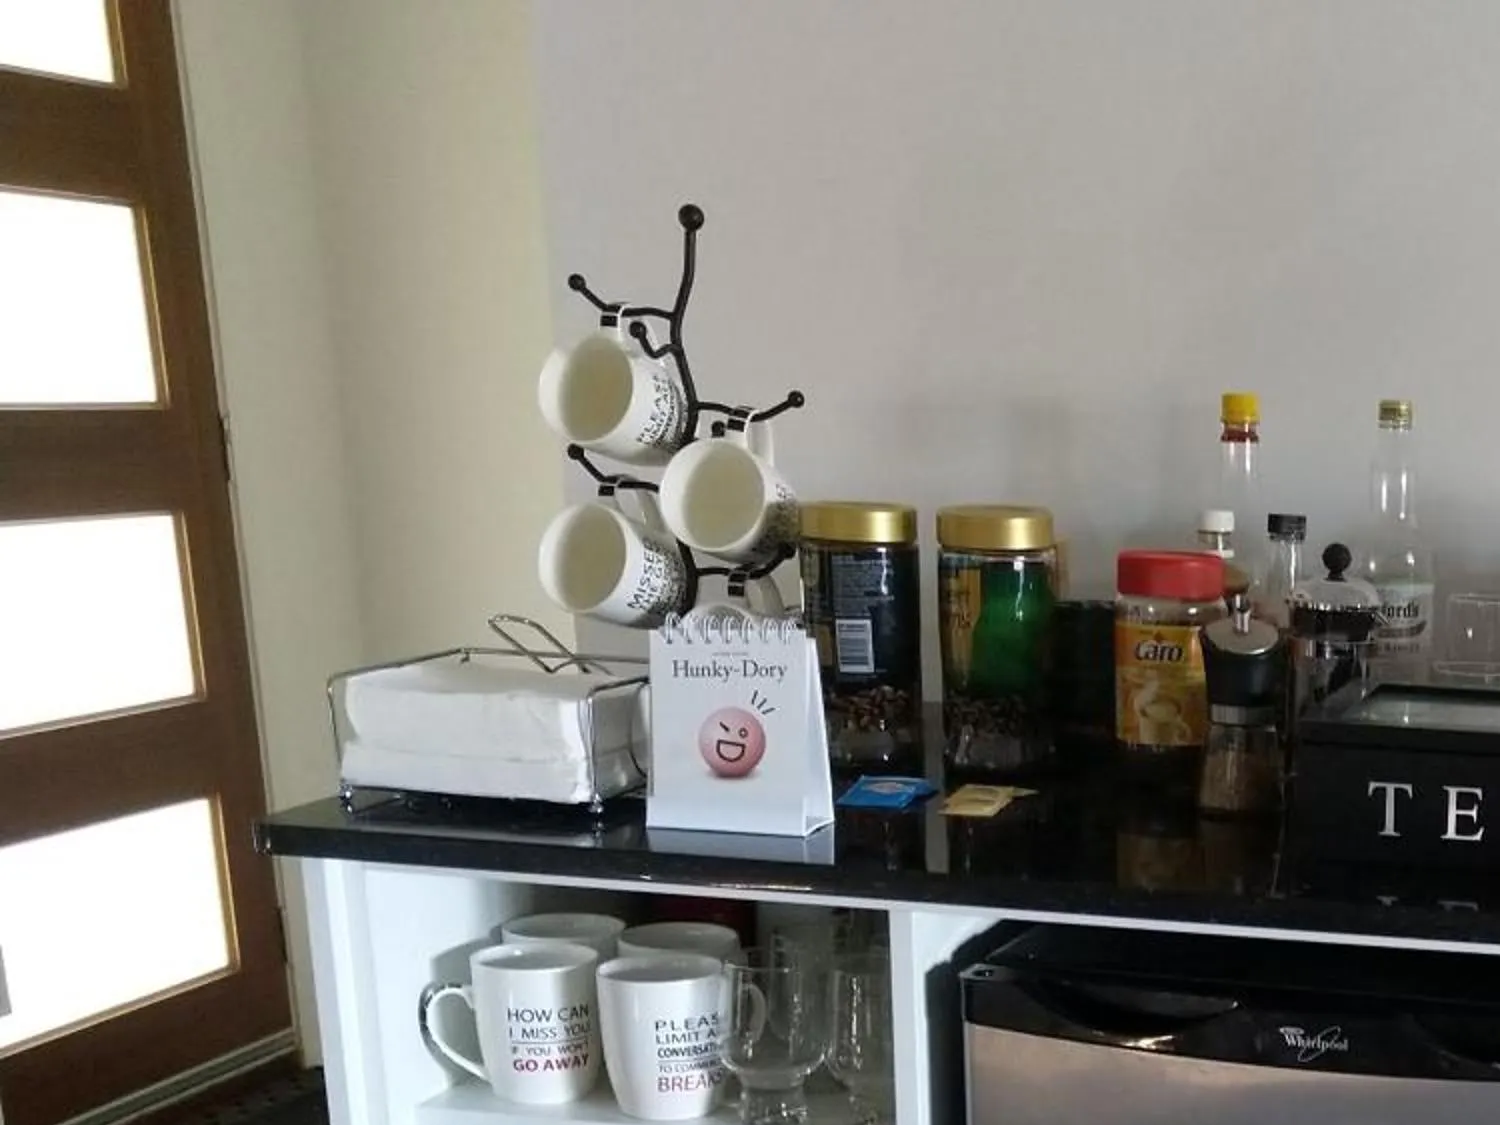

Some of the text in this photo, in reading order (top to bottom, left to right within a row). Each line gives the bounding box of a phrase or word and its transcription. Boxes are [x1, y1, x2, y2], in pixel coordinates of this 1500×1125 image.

[1135, 640, 1184, 662] Caro
[672, 658, 788, 684] Hunky-Dory
[506, 1003, 590, 1024] HOW CAN
[654, 1011, 721, 1032] PLEAS
[508, 1022, 592, 1040] I MISS YOU
[655, 1031, 700, 1045] LIMIT
[526, 1045, 552, 1057] YOU
[1279, 1026, 1349, 1061] Whirlpool
[512, 1055, 590, 1073] GO AWAY
